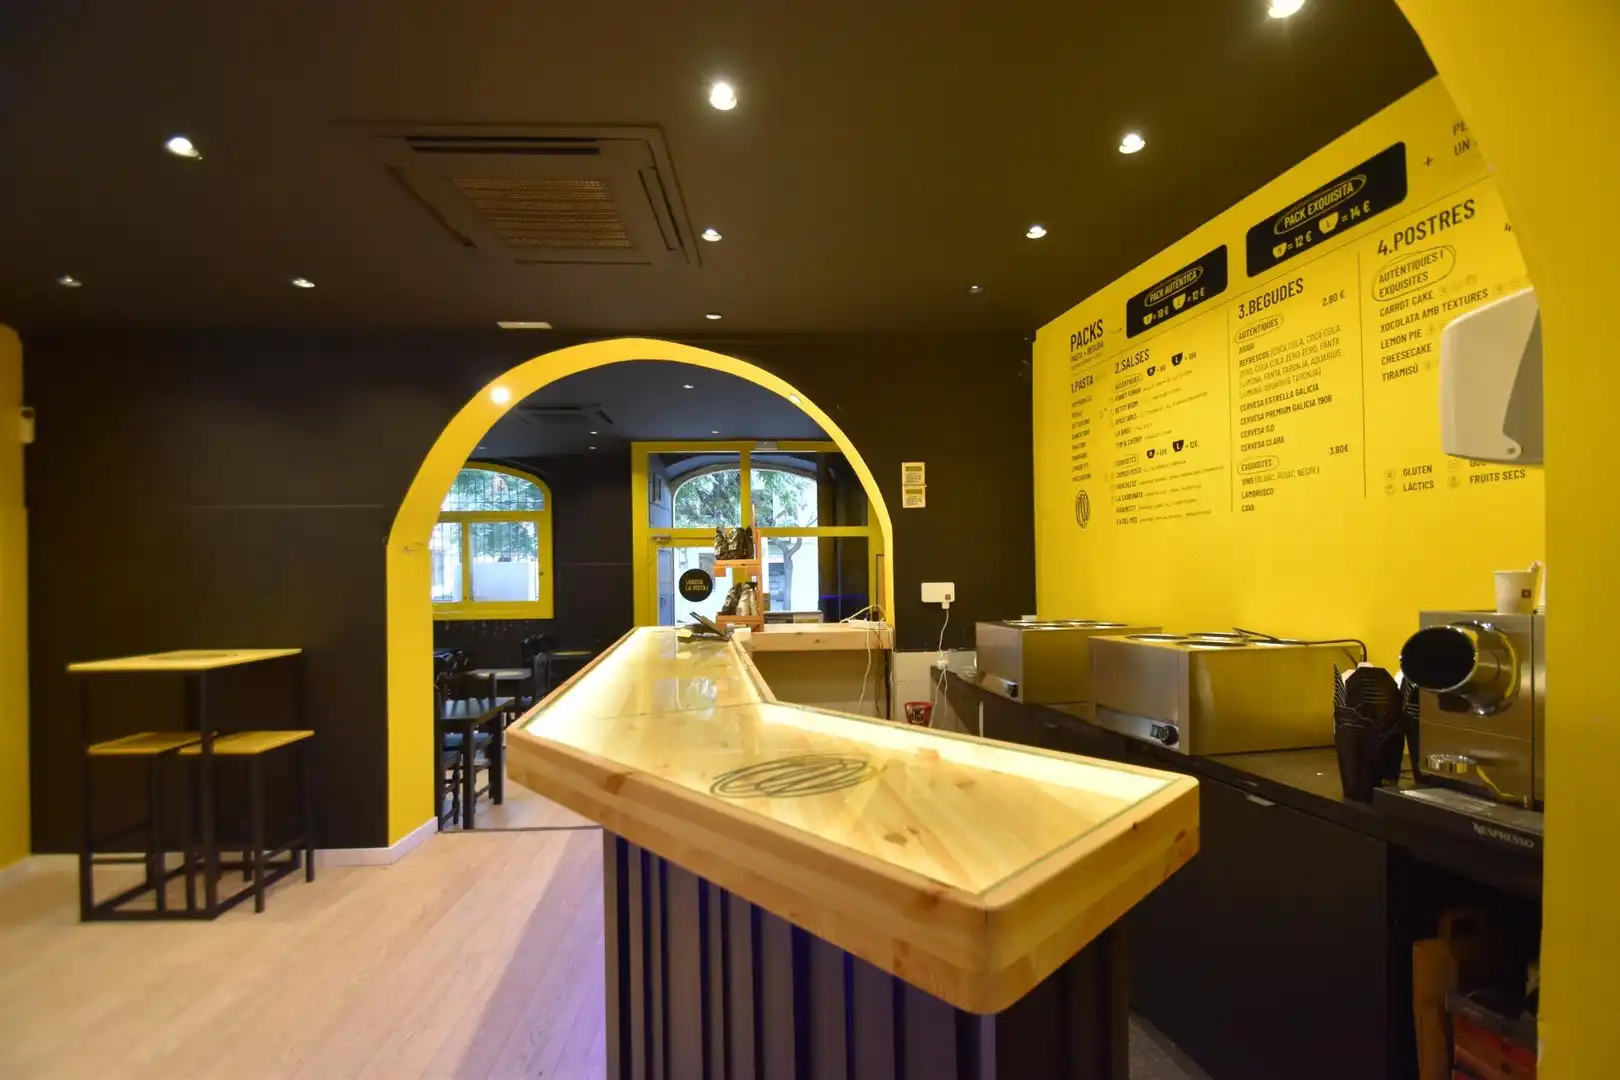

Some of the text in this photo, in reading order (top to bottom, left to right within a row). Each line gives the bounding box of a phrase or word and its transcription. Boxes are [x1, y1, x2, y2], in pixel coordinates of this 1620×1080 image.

[1284, 181, 1354, 229] PACK EXQUISITA
[1294, 235, 1304, 249] 12
[1305, 230, 1313, 242] €
[1349, 205, 1361, 221] 14
[1363, 200, 1371, 213] €
[1377, 198, 1476, 256] 4.POSTRES
[1149, 288, 1164, 303] PACK
[1379, 271, 1429, 298] EXQUISITES
[1238, 277, 1304, 319] 3.BEGUDES
[1379, 290, 1434, 317] CARROT CAKE
[1380, 288, 1489, 334] XOCOLATA AMB TEXTURES
[1070, 318, 1104, 353] PACKS
[1380, 328, 1423, 350] LEMON PIE
[1114, 348, 1150, 374] 2.SALSES
[1239, 350, 1270, 367] REFRESCOS
[1381, 342, 1433, 366] CHEESECAKE
[1239, 383, 1319, 413] CERVESA ESTRELLA GALICIA
[1240, 411, 1264, 426] CERVESA
[1265, 405, 1292, 419] PREMIUM
[1292, 398, 1316, 412] GALICIA
[1240, 426, 1265, 439] CERVESA
[1240, 435, 1285, 452] CERVESA CLARA
[1402, 464, 1433, 477] GLUTEN
[1469, 469, 1526, 484] FRUITS SECS
[1241, 487, 1274, 500] LAMBRUSCO
